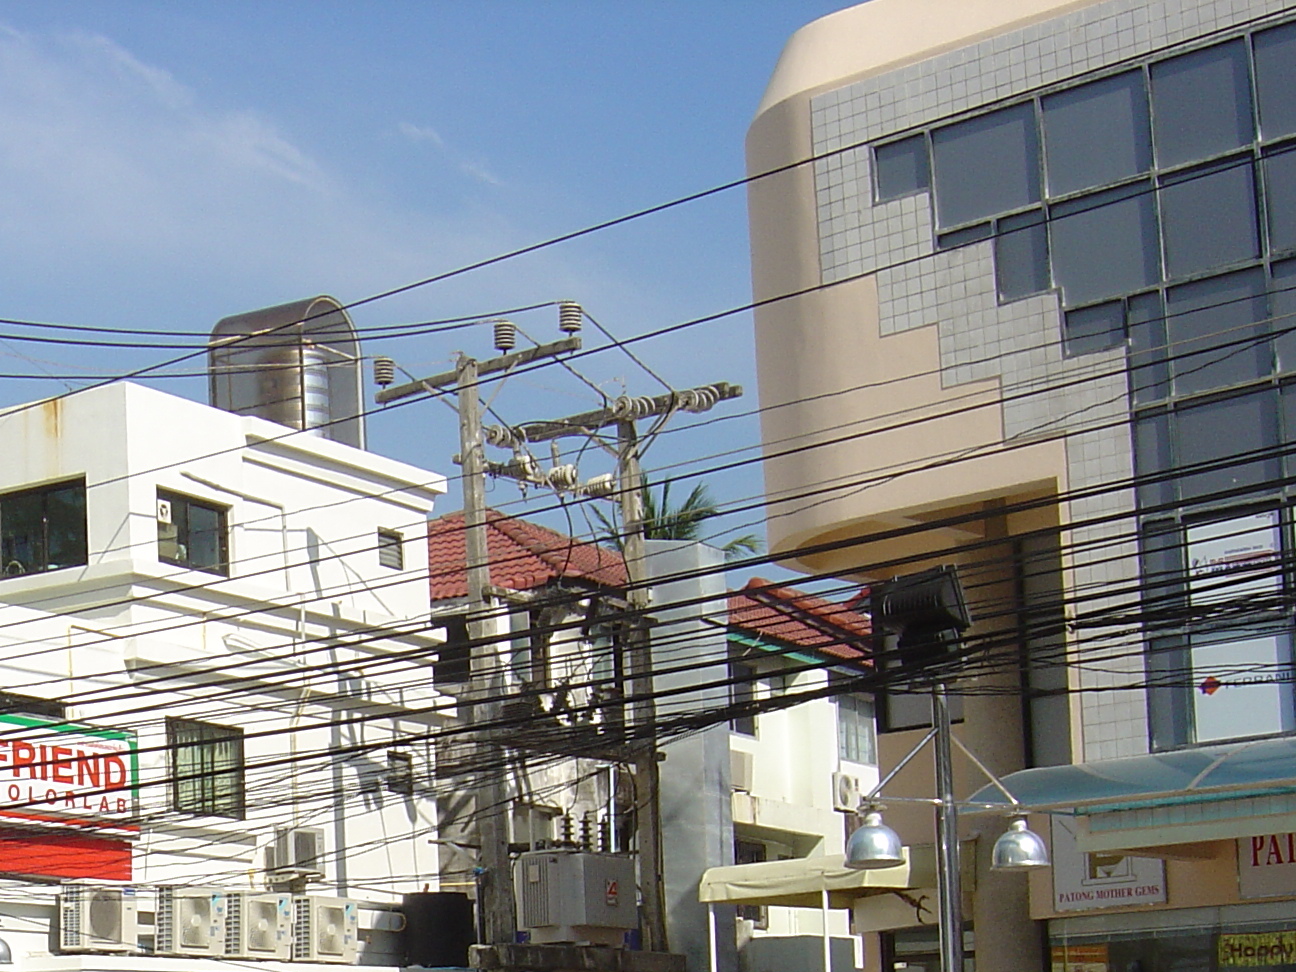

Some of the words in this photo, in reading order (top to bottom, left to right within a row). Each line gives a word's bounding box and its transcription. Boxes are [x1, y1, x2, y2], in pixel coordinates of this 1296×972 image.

[1059, 890, 1094, 903] PATONG
[1095, 887, 1133, 900] MOTHER
[1135, 885, 1160, 898] GEMS
